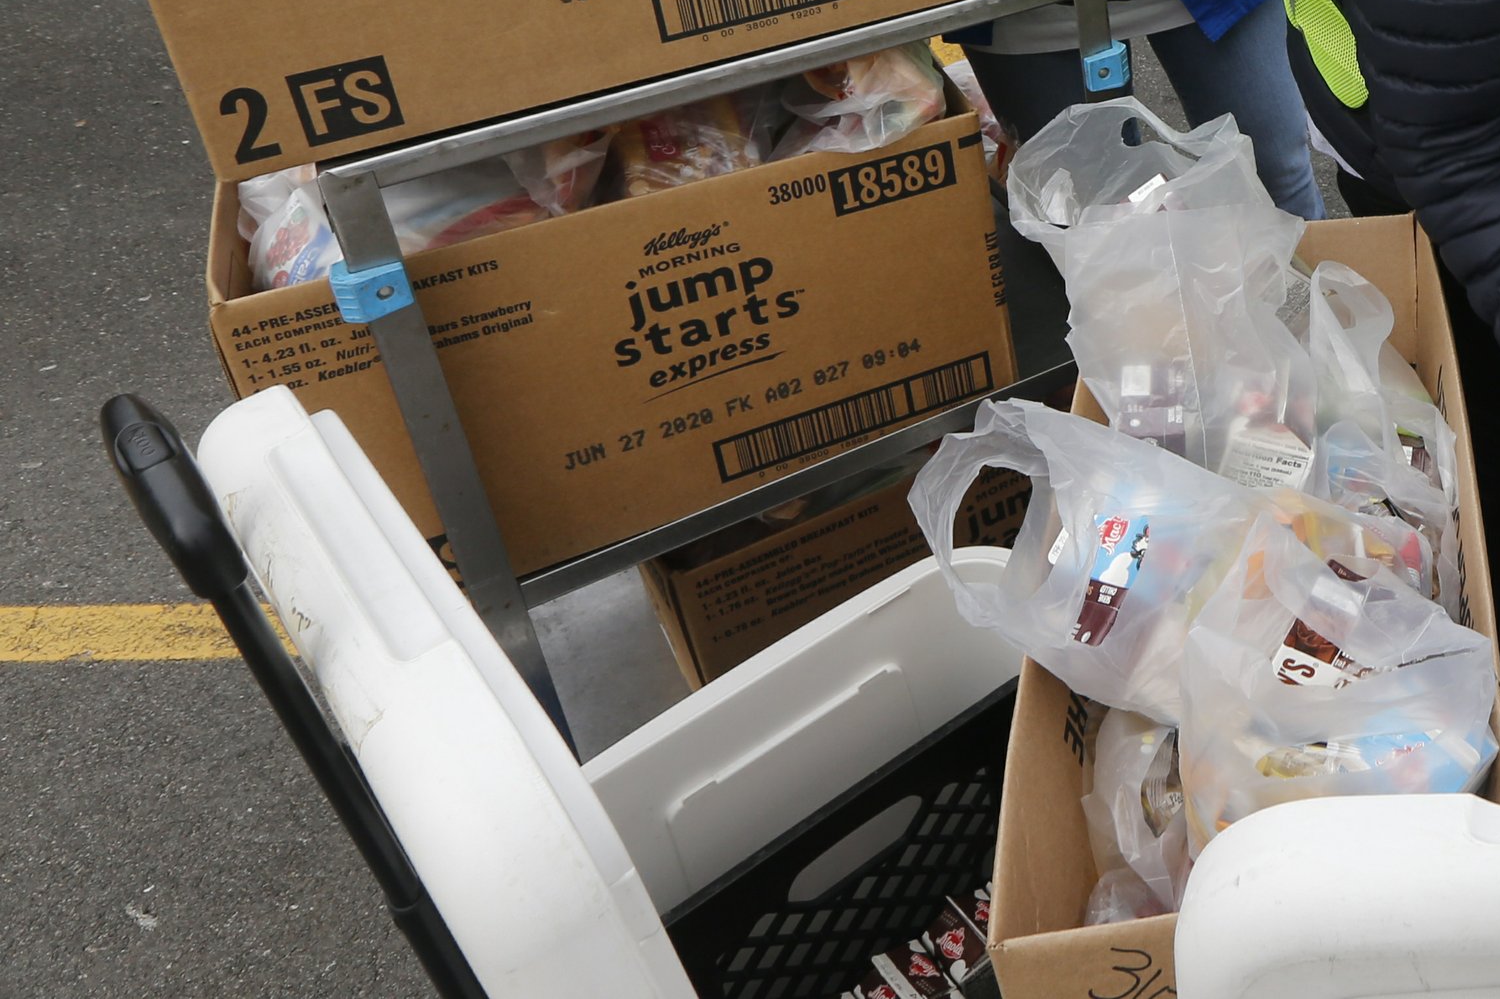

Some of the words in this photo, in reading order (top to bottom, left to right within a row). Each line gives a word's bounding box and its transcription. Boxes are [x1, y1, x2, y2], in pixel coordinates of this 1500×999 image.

[745, 16, 779, 33] 38000
[790, 6, 822, 22] 19203
[219, 87, 283, 165] 2
[299, 69, 391, 136] FS
[768, 174, 827, 205] 38000
[838, 149, 946, 210] 18589
[638, 242, 741, 279] MORNING
[231, 301, 341, 339] 44-PRE-ASSE
[412, 268, 464, 292] AKFAST
[468, 260, 499, 277] KITS
[625, 255, 774, 331] jump
[235, 335, 271, 352] EACH
[275, 317, 343, 342] COMPRISE
[262, 346, 295, 364] 4.23
[321, 338, 342, 348] oz.
[350, 328, 371, 342] Jui
[268, 362, 300, 380] 1.55
[305, 358, 327, 371] oz.
[428, 318, 458, 336] Bars
[460, 300, 532, 327] Strawberry
[483, 313, 534, 335] Original
[649, 332, 771, 388] express
[564, 443, 606, 471] JUN
[619, 429, 646, 453] 27
[660, 408, 714, 440] 2020
[725, 394, 753, 418] FK
[1276, 456, 1302, 468] Facts
[975, 472, 1019, 502] MORN
